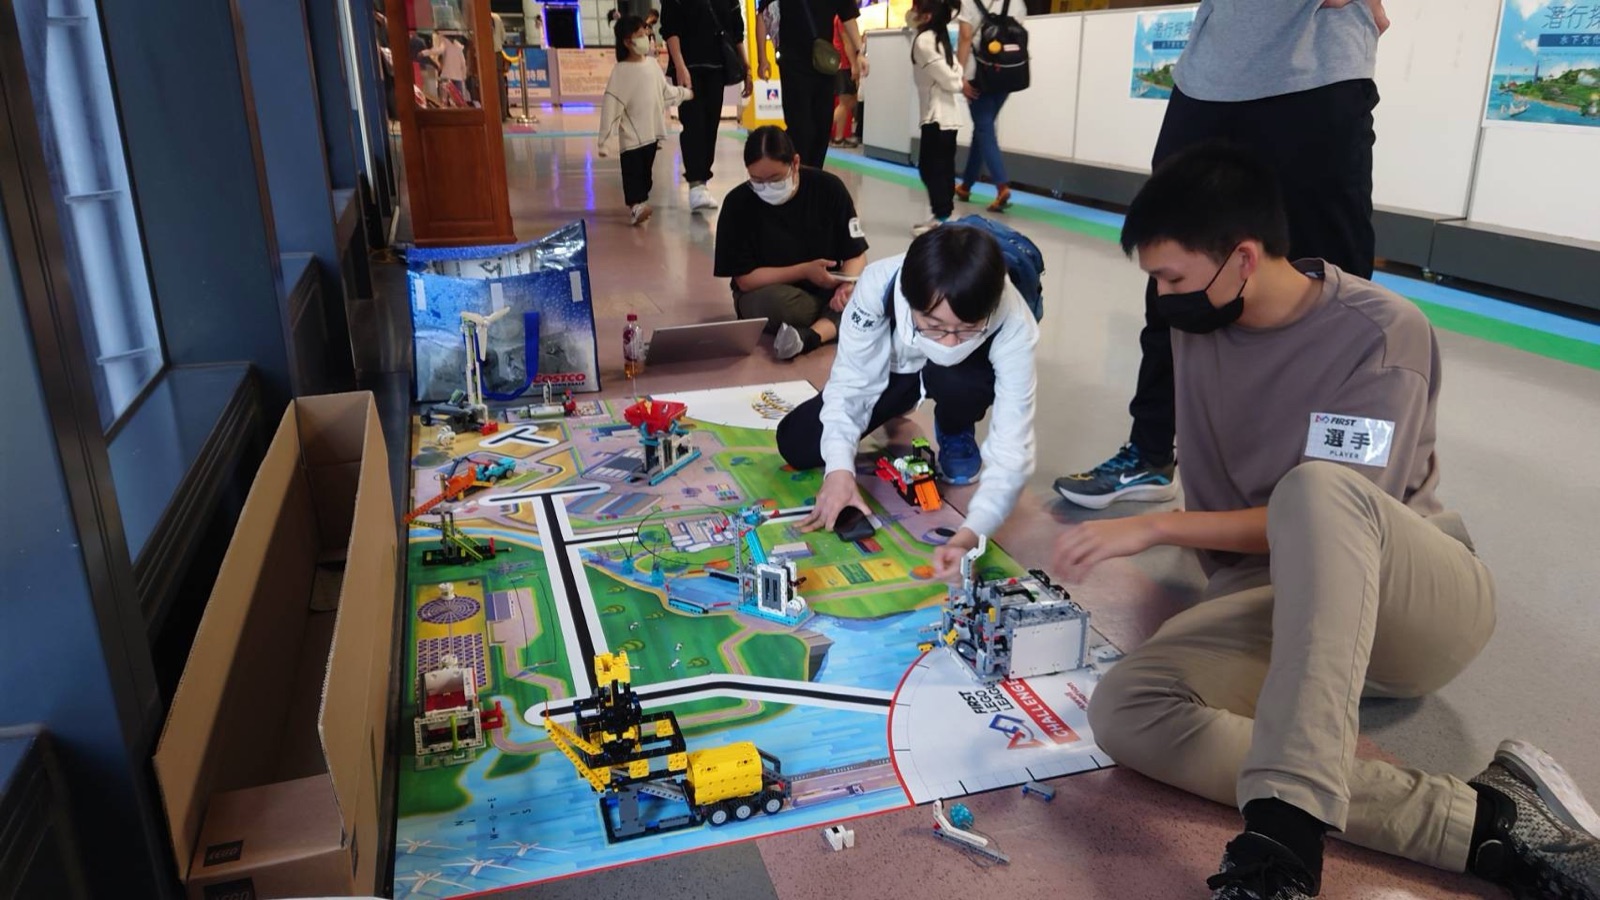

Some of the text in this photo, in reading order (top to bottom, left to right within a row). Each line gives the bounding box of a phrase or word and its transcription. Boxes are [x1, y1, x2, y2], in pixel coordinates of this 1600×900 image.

[533, 372, 586, 383] COSTCO
[1330, 416, 1357, 427] FIRST
[1323, 428, 1371, 450] 選手
[1330, 451, 1359, 459] PLAYER
[958, 690, 989, 715] FIRST
[975, 689, 1002, 714] LEGO
[1005, 677, 1069, 737] CHALLENGE
